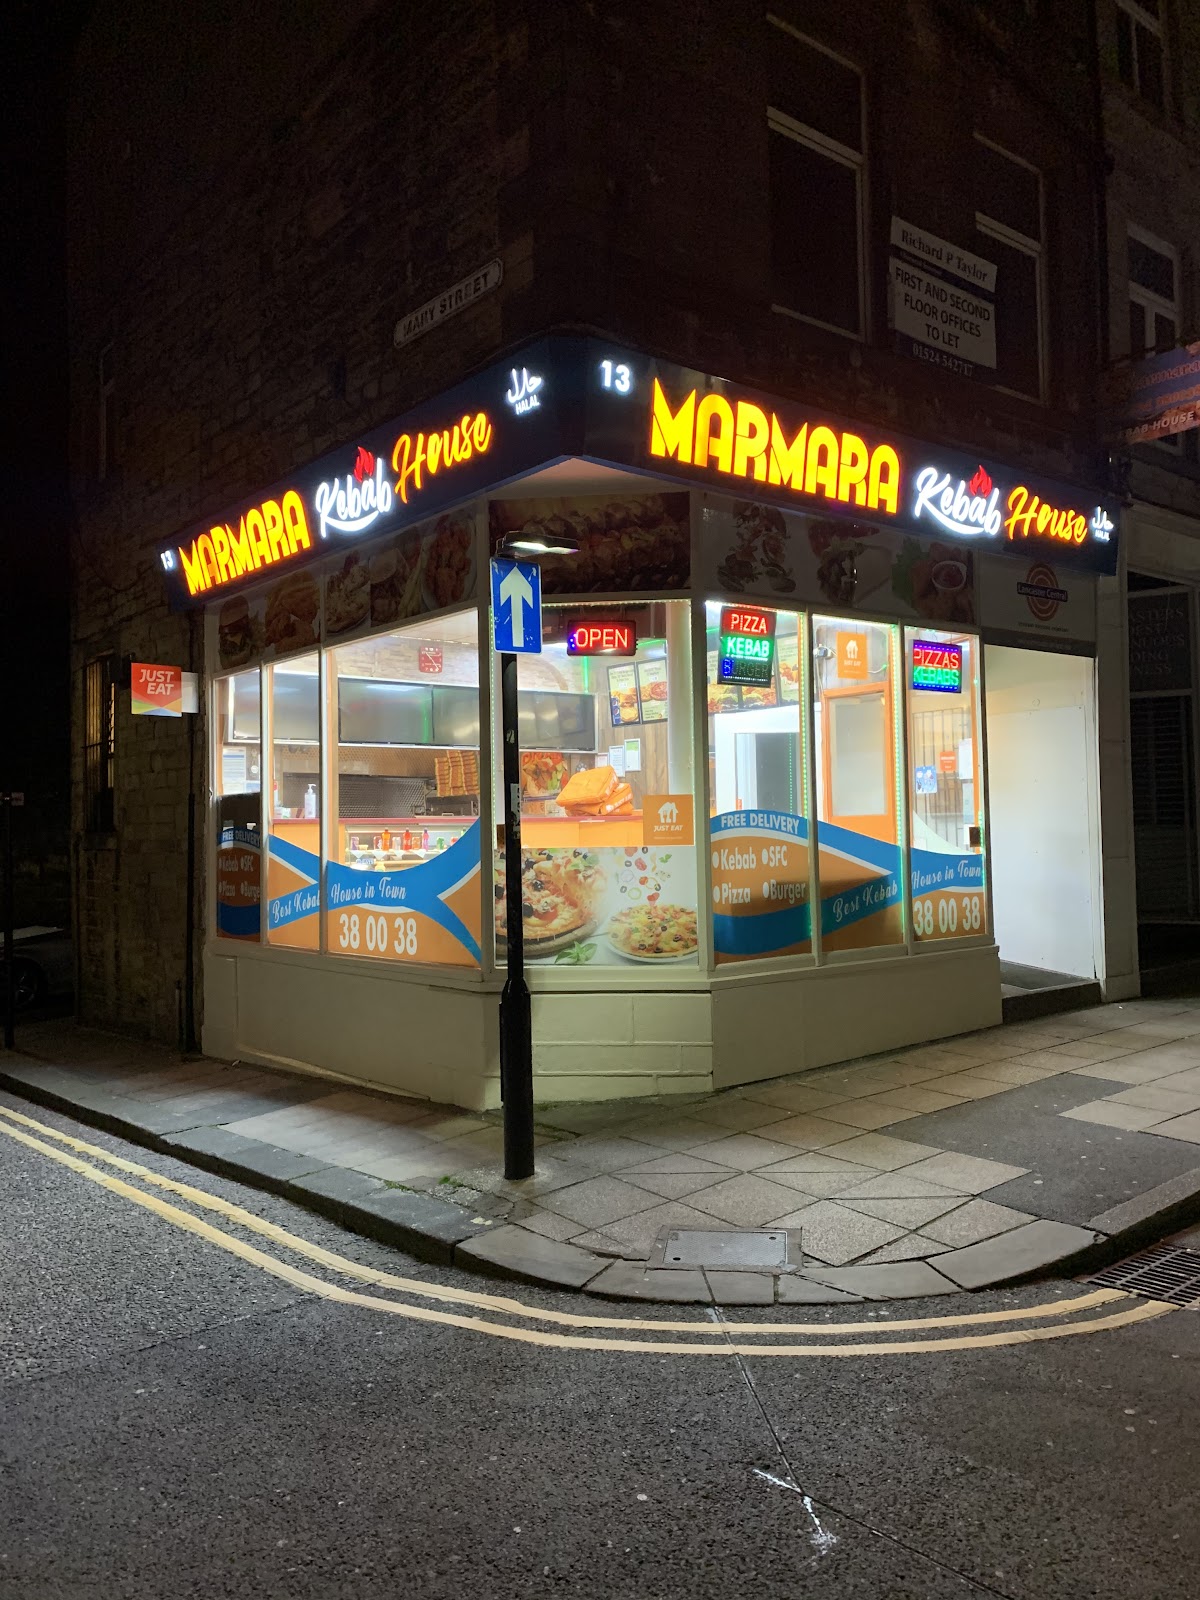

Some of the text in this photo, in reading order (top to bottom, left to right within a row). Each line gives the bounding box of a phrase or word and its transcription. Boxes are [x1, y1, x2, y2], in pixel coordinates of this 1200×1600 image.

[902, 229, 942, 260] Richard
[947, 252, 954, 264] P
[957, 256, 988, 282] Taylor
[440, 272, 489, 314] STREET
[896, 267, 990, 321] FIRST AND SECOND
[904, 293, 981, 337] FLOOR OFFICES
[925, 324, 960, 348] TO LET
[912, 343, 940, 363] 01524
[516, 394, 540, 414] HALAL
[1153, 411, 1195, 429] HOUSE
[601, 360, 1088, 544] 13 MARMARA Kebab House
[160, 411, 492, 596] 13 MARMARA Kebab House
[1046, 589, 1067, 600] Central
[731, 613, 767, 634] PIZZA
[576, 628, 628, 648] OPEN
[727, 636, 770, 657] KEBAB
[724, 658, 768, 678] BURGER
[913, 648, 959, 669] PIZZAS
[139, 668, 174, 683] JUST
[913, 666, 959, 686] KEBABS
[147, 682, 174, 696] EAT
[721, 813, 799, 834] FREE DELIVERY
[222, 831, 234, 842] FREE
[222, 854, 239, 872] Kebab
[721, 845, 787, 870] Kebab SFC
[911, 859, 981, 889] House in Town
[223, 880, 260, 902] Pizza Burge
[331, 877, 407, 904] House in Town
[722, 879, 806, 904] Pizza Burger
[272, 900, 291, 923] Best
[833, 882, 898, 922] Best Kebab
[913, 896, 981, 936] 38 00 38
[339, 913, 417, 955] 38 00 38
